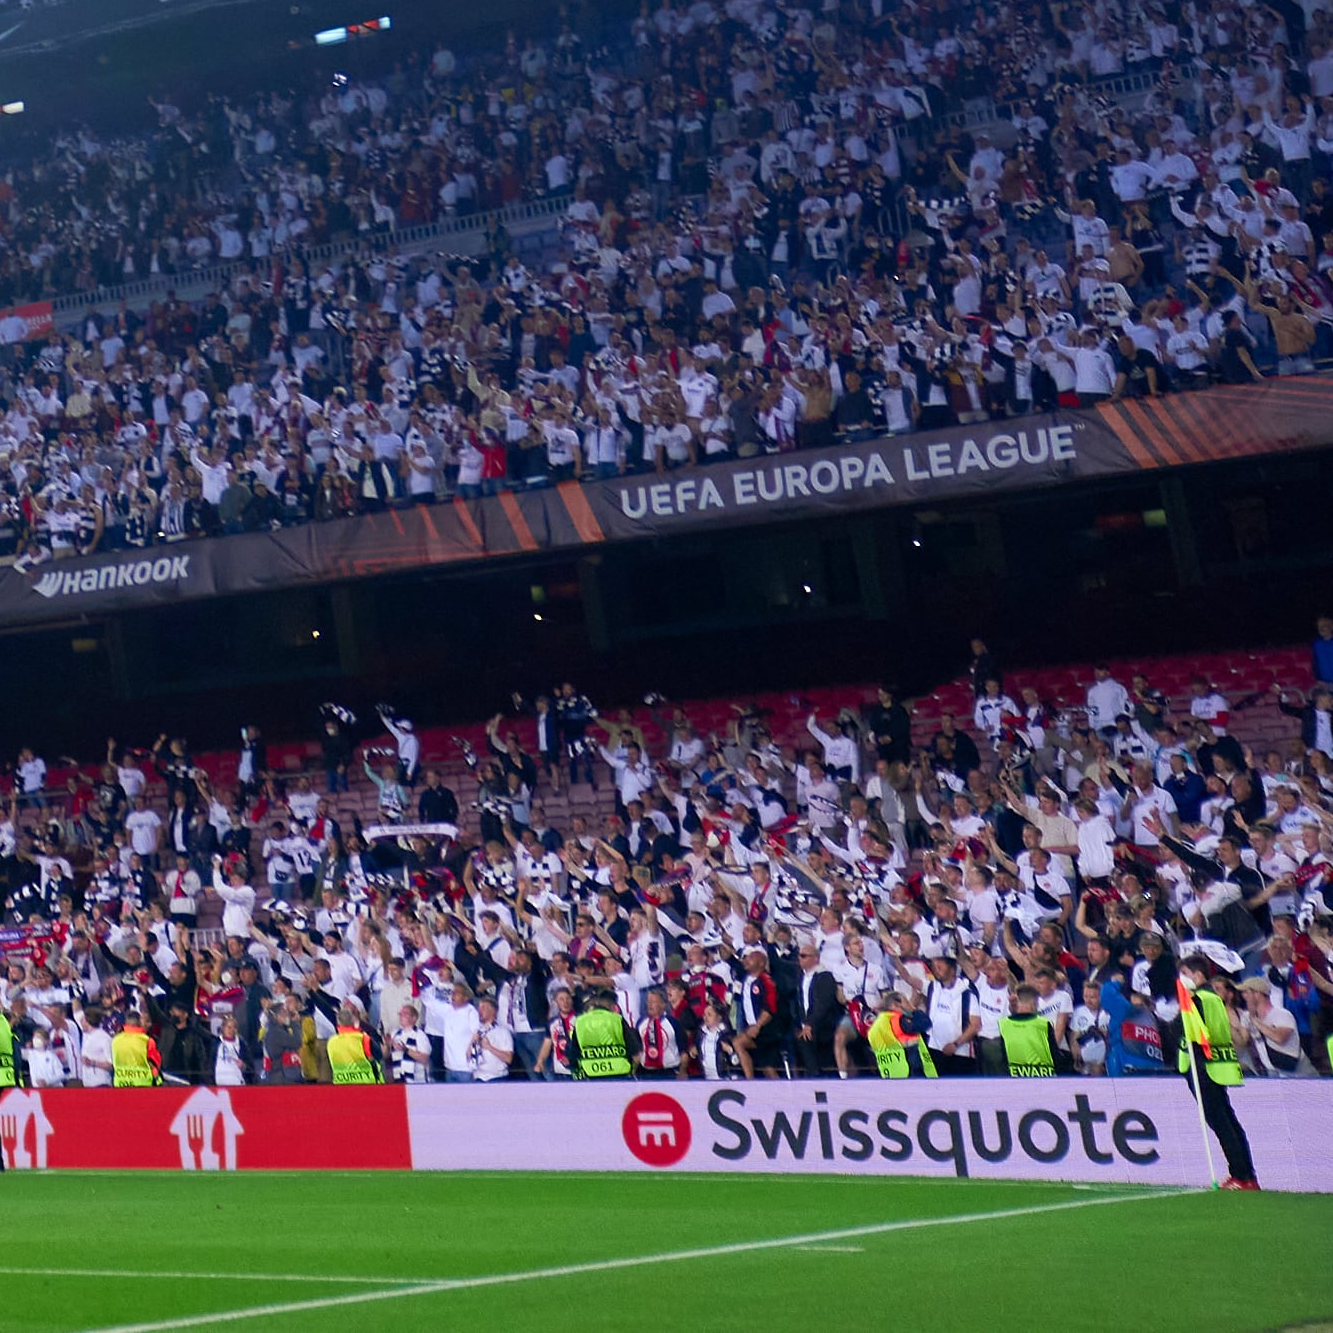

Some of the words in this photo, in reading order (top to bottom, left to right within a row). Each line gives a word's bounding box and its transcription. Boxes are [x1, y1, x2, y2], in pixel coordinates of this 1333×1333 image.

[620, 477, 725, 519] UEFA
[734, 452, 896, 505] EUROPA
[903, 424, 1077, 482] LEAGUE
[582, 1044, 627, 1060] TEWARD
[591, 1061, 615, 1073] 061
[707, 1088, 1160, 1177] Swissquote
